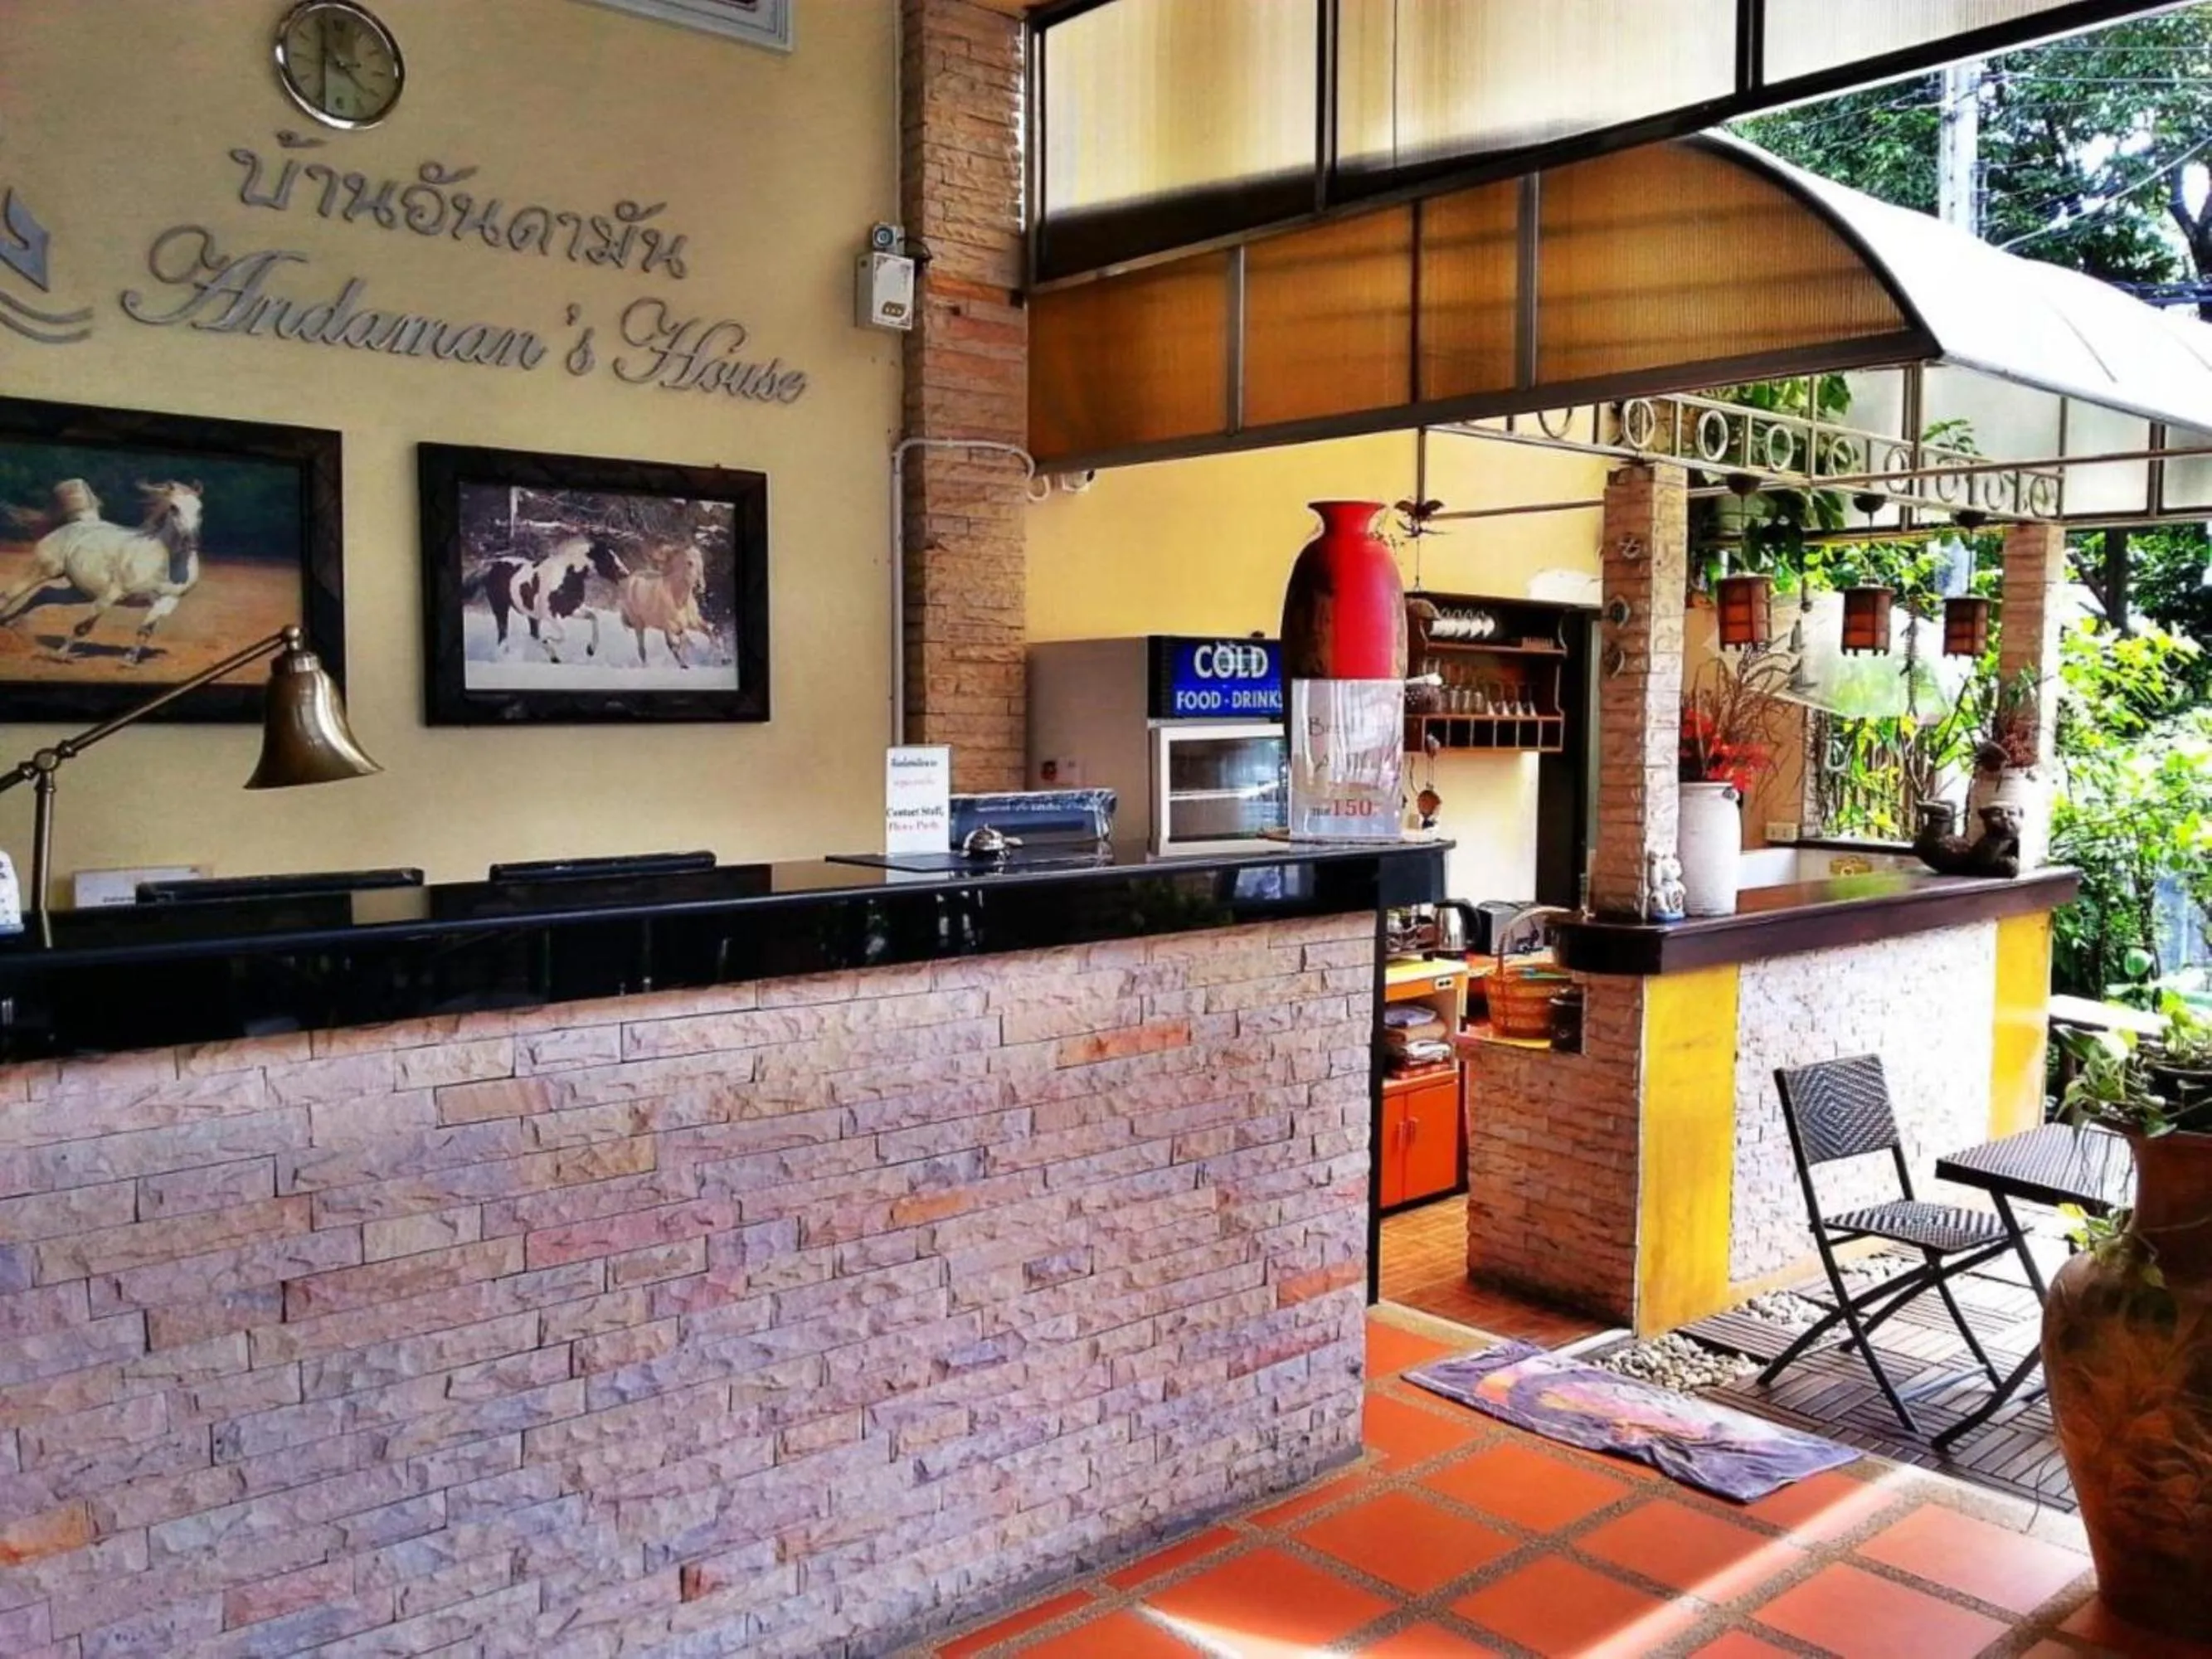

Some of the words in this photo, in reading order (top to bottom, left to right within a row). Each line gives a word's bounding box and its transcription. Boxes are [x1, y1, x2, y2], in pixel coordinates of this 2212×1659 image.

[229, 131, 688, 279] บ้านอันดามัน
[612, 297, 807, 405] House
[1194, 644, 1269, 679] COLD
[1176, 690, 1222, 710] FOOD
